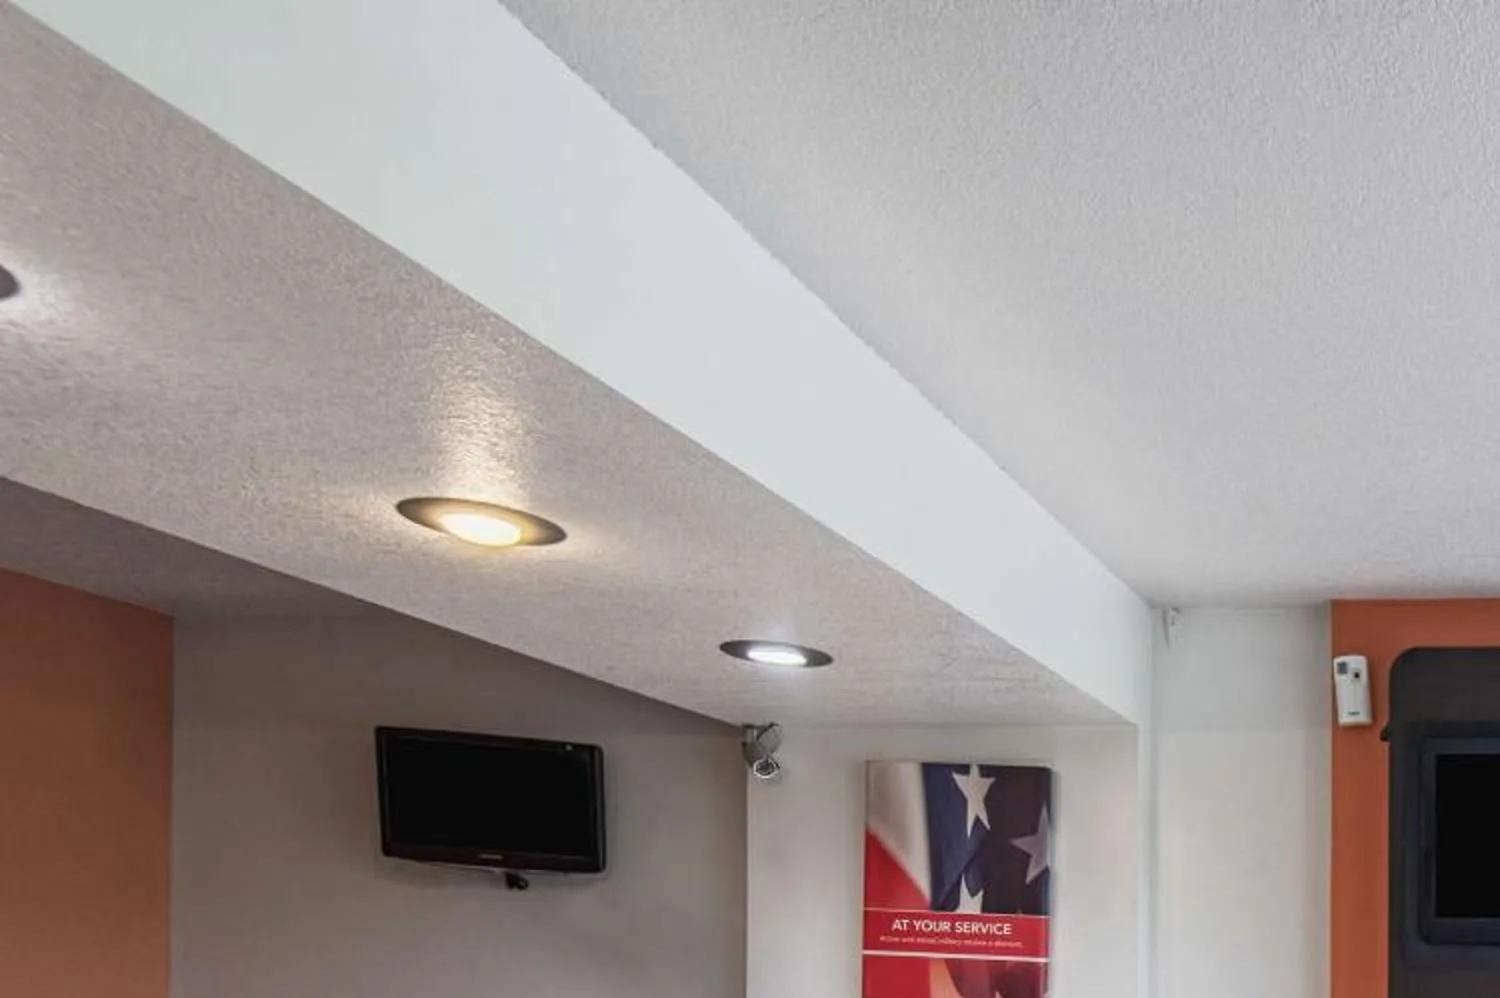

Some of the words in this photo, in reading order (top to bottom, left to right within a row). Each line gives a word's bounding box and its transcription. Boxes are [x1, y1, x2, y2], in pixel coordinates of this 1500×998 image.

[891, 919, 910, 931] AT
[912, 919, 952, 933] YOUR
[954, 921, 1013, 935] SERVICE
